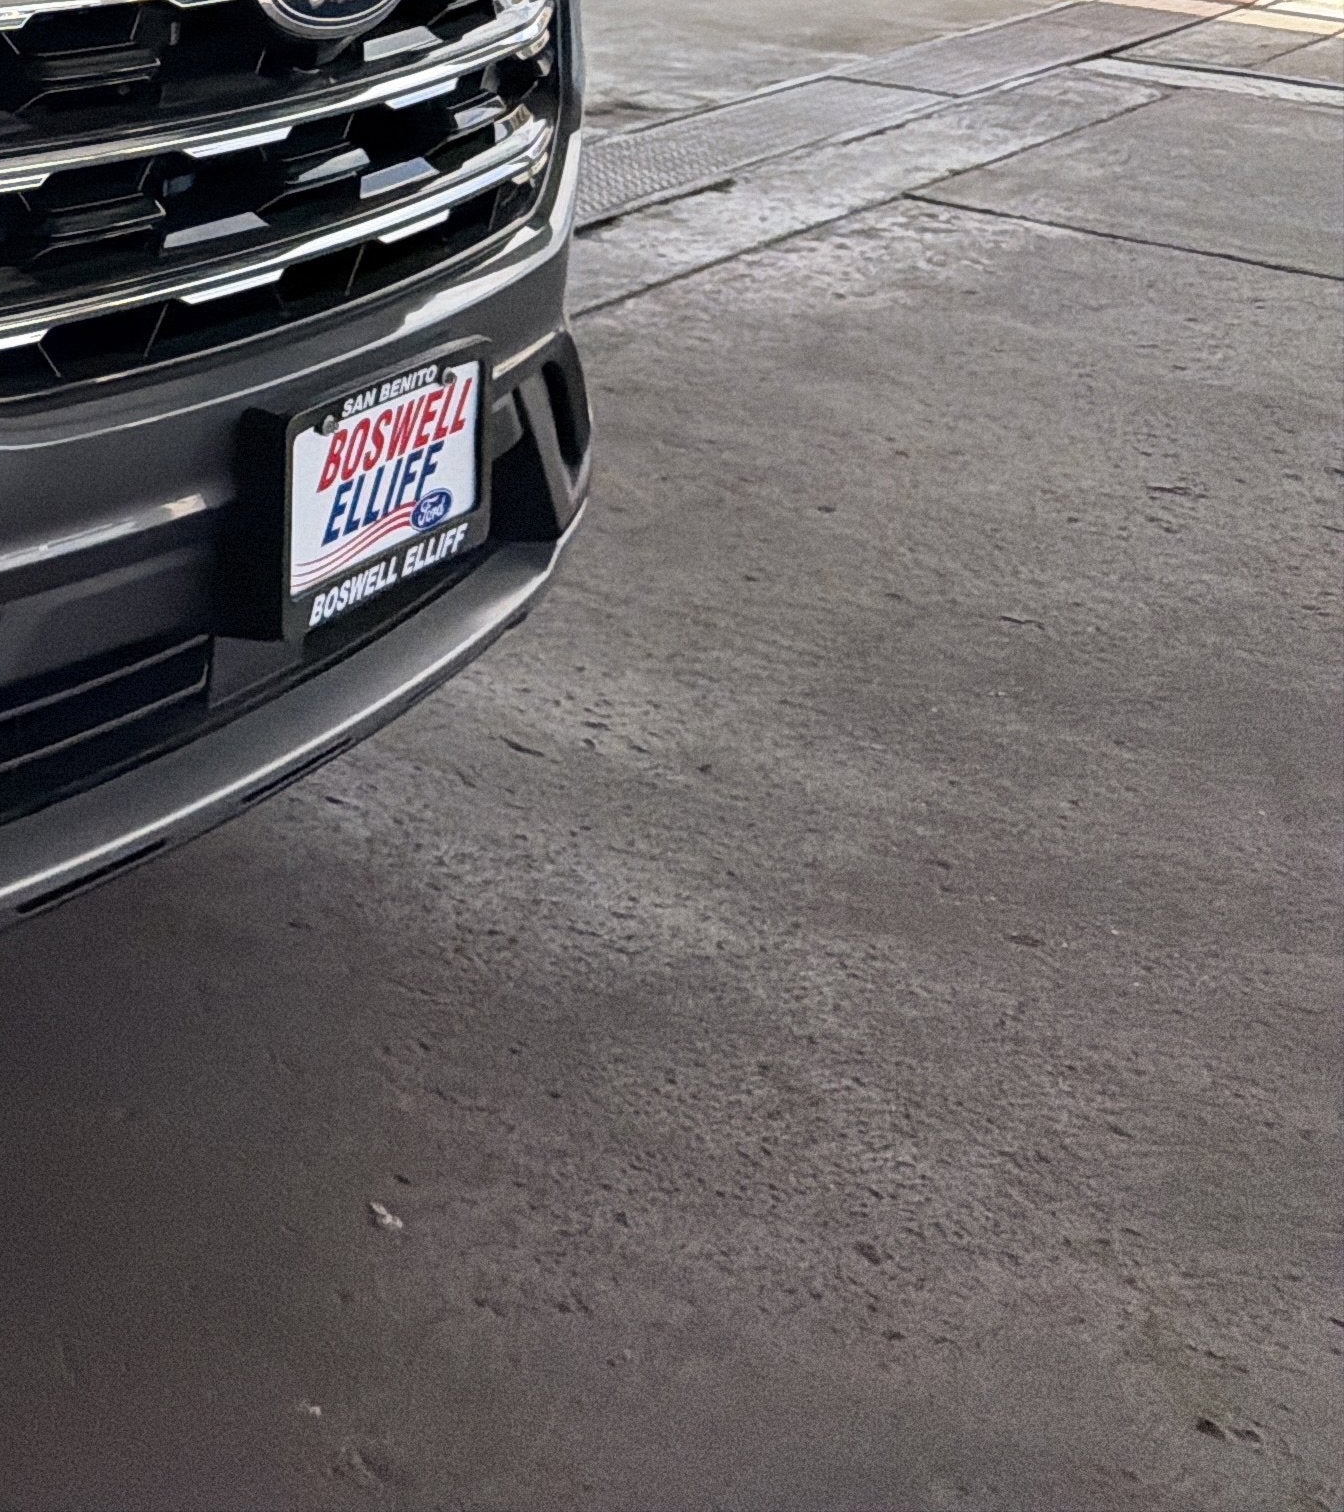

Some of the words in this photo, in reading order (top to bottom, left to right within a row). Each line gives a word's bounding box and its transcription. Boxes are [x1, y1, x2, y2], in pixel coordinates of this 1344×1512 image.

[316, 377, 473, 494] BOSWELL
[342, 388, 377, 418] SAN
[378, 364, 438, 405] BENITO
[321, 439, 445, 548] ELLIFF
[417, 494, 447, 527] Ford
[309, 556, 398, 627] BOSWELL
[402, 522, 469, 578] ELLIFF
